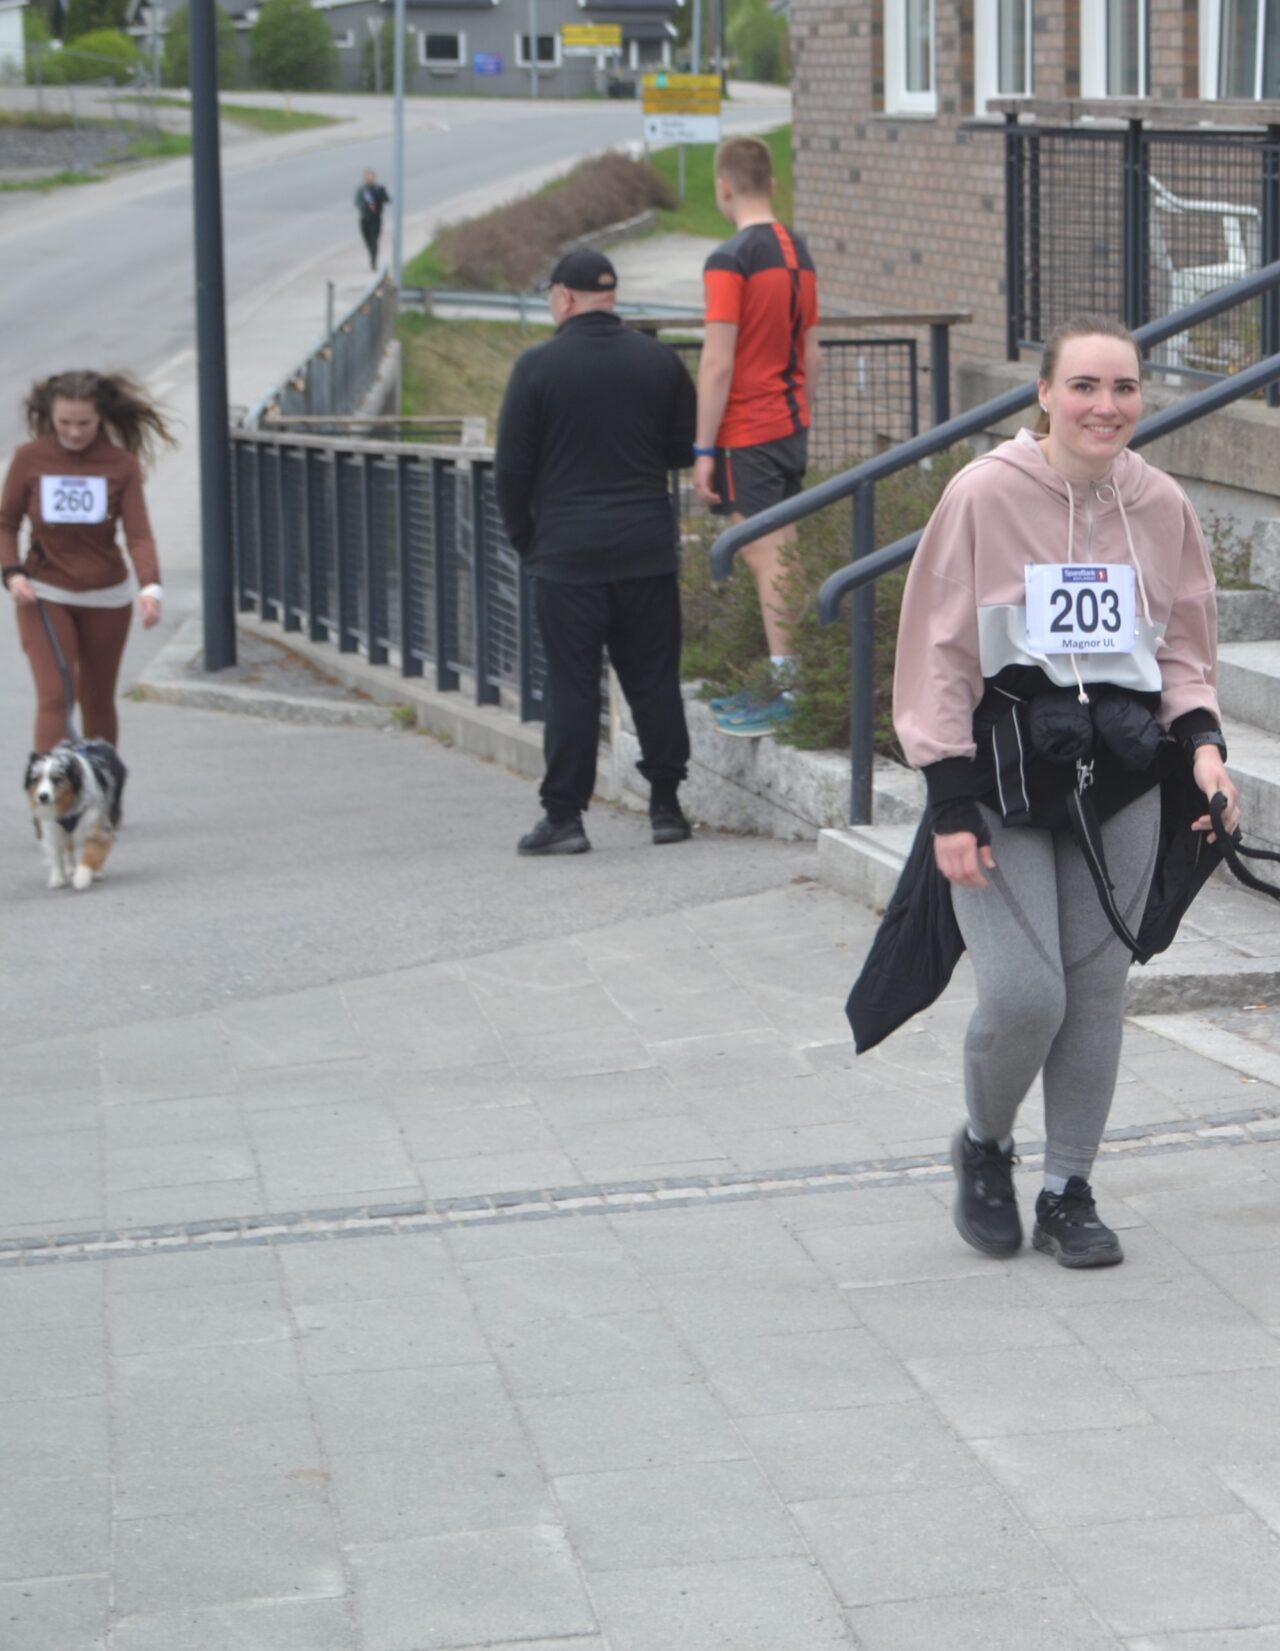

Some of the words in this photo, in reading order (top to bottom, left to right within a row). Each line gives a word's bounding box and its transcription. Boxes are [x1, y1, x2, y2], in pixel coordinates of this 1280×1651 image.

[54, 489, 94, 512] 260
[1050, 588, 1121, 633] 203
[1062, 639, 1100, 650] Magnor
[1103, 638, 1115, 647] UL
